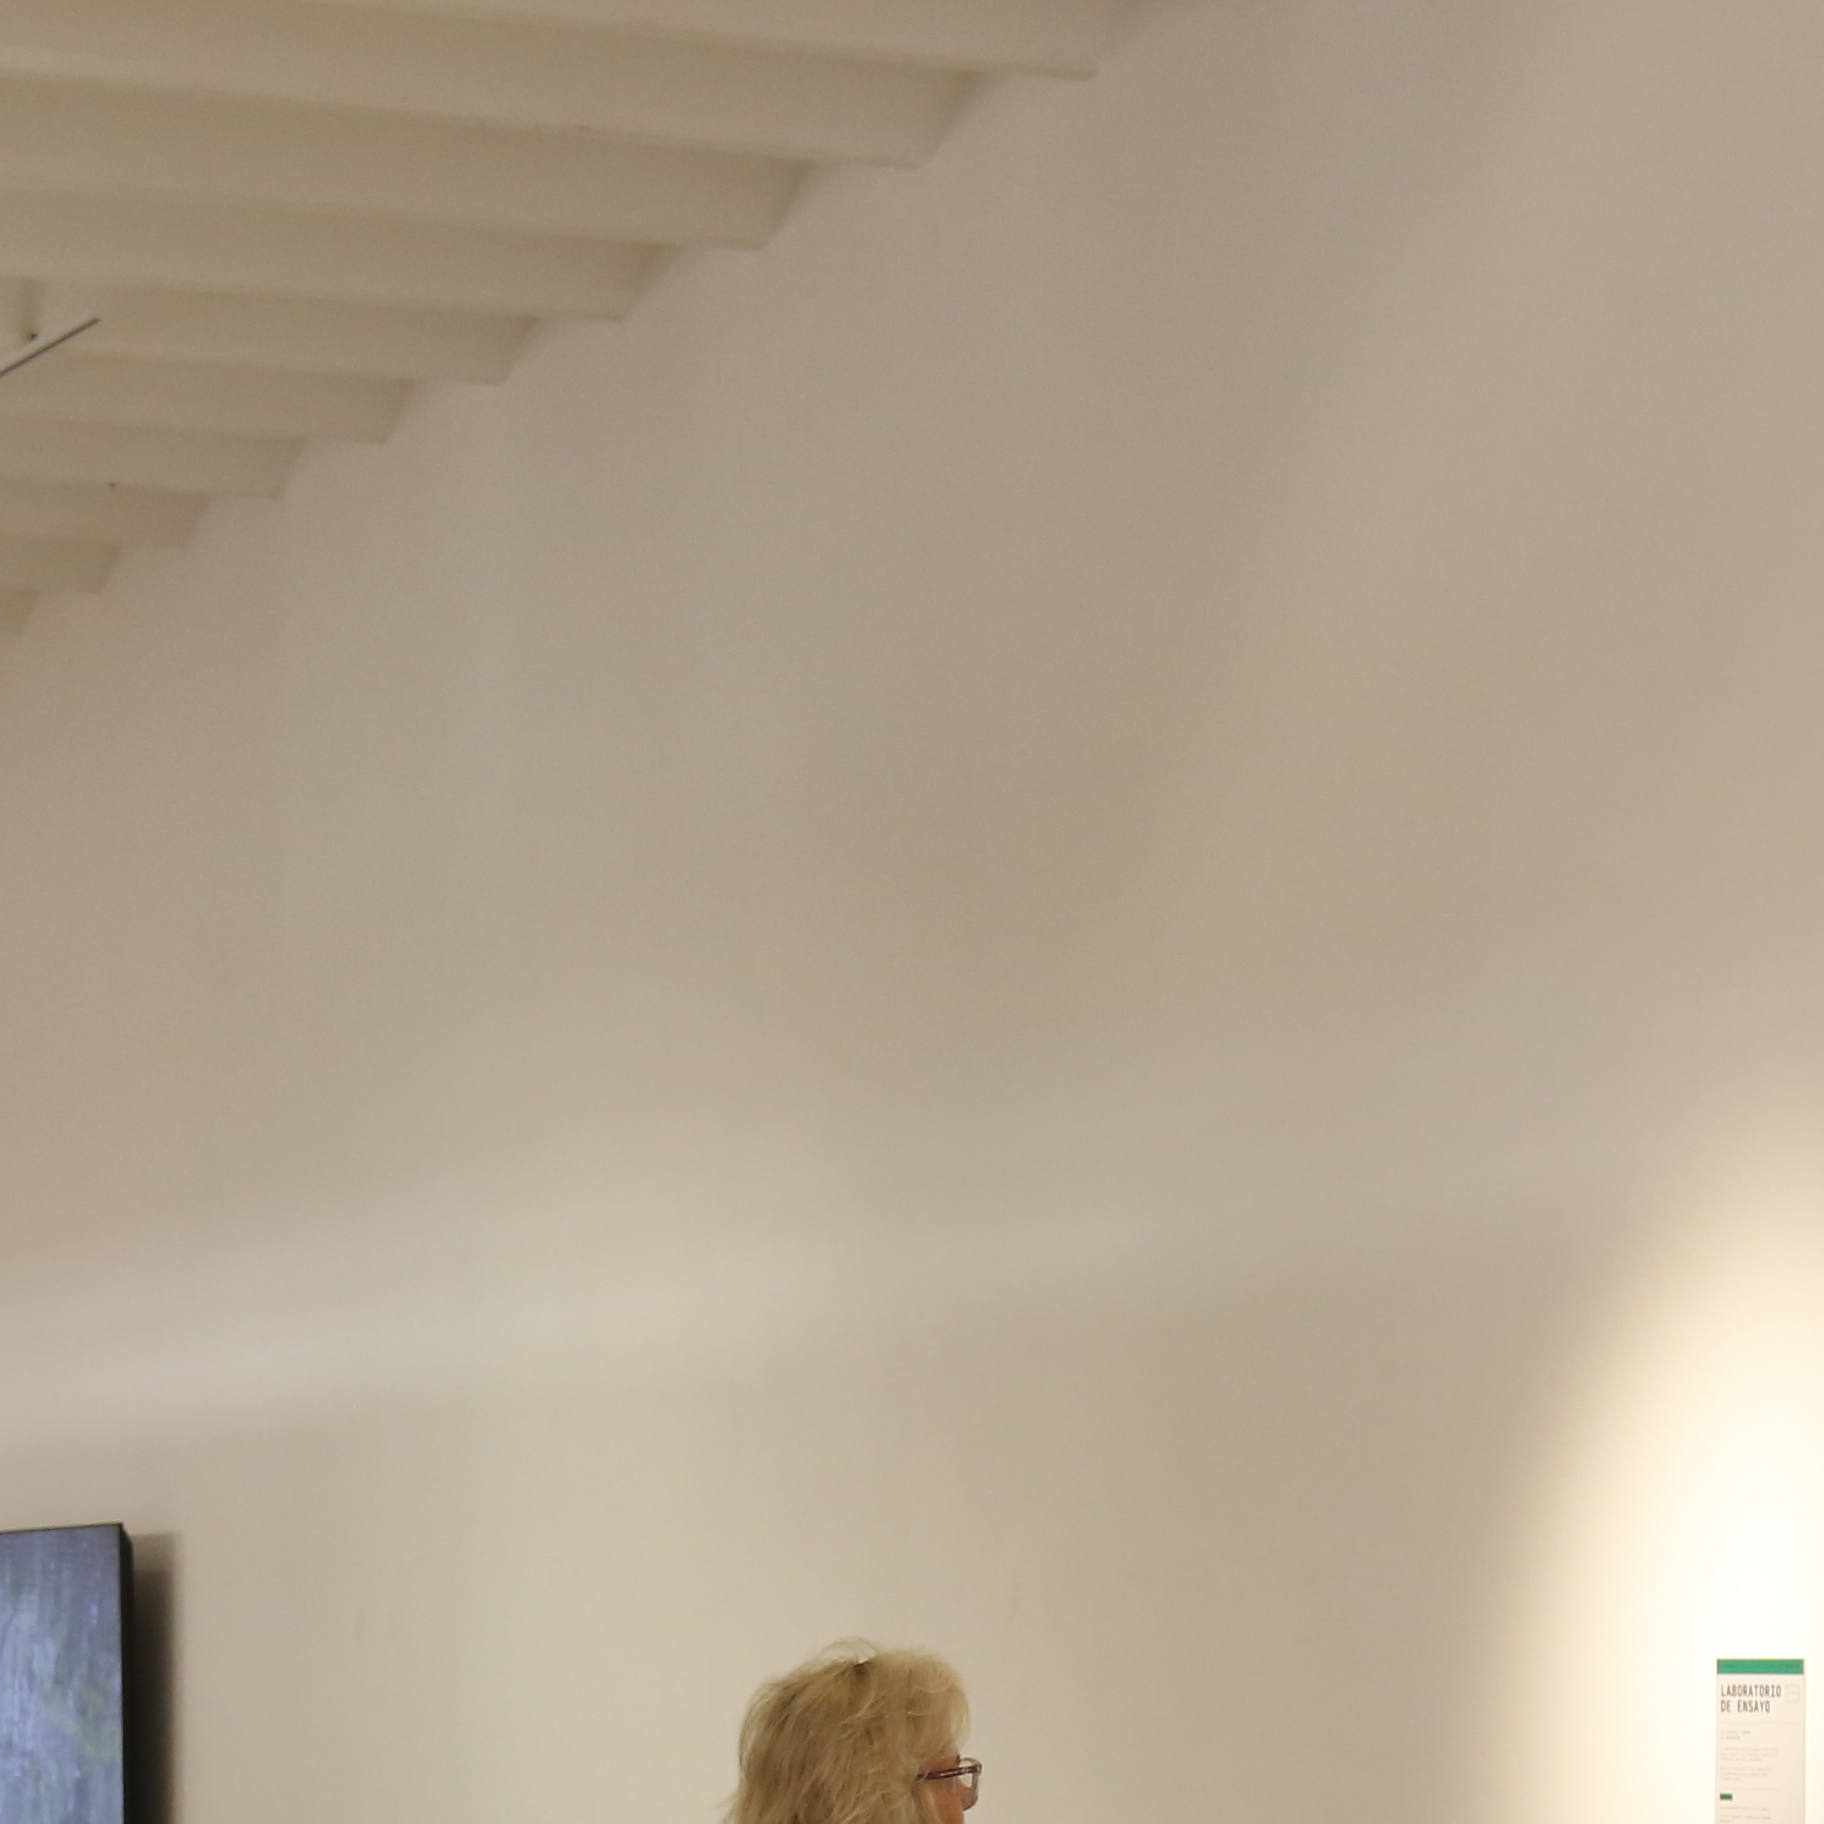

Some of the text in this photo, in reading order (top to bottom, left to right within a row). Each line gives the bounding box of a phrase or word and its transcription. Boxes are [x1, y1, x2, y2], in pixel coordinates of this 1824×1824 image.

[1720, 1684, 1782, 1698] LABORATORIO
[1720, 1699, 1771, 1713] DE ENSAYO
